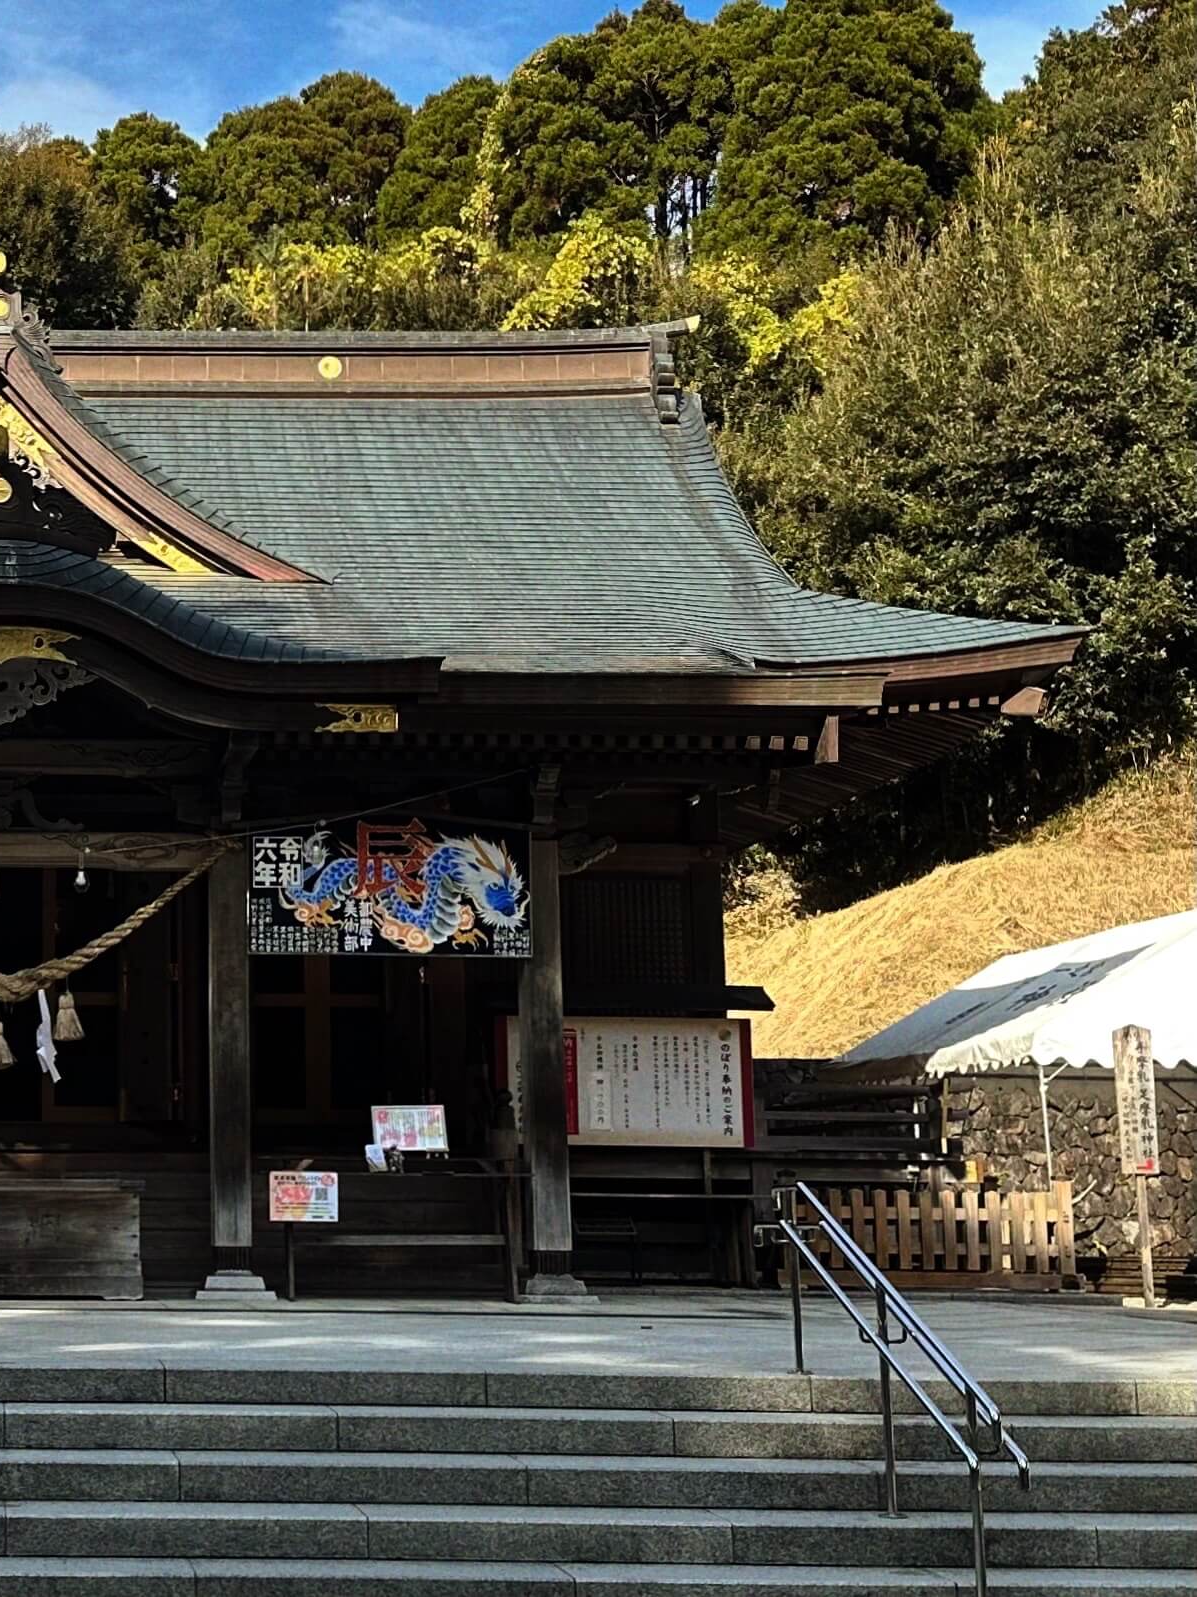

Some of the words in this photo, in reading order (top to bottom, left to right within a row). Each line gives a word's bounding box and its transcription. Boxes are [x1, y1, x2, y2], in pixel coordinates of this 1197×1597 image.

[254, 838, 278, 886] 六年
[279, 838, 302, 886] 令和
[349, 818, 427, 898] 辰
[343, 898, 359, 953] 美術部
[358, 900, 374, 952] 都農中
[720, 1043, 734, 1137] のぼり奉納のご案内
